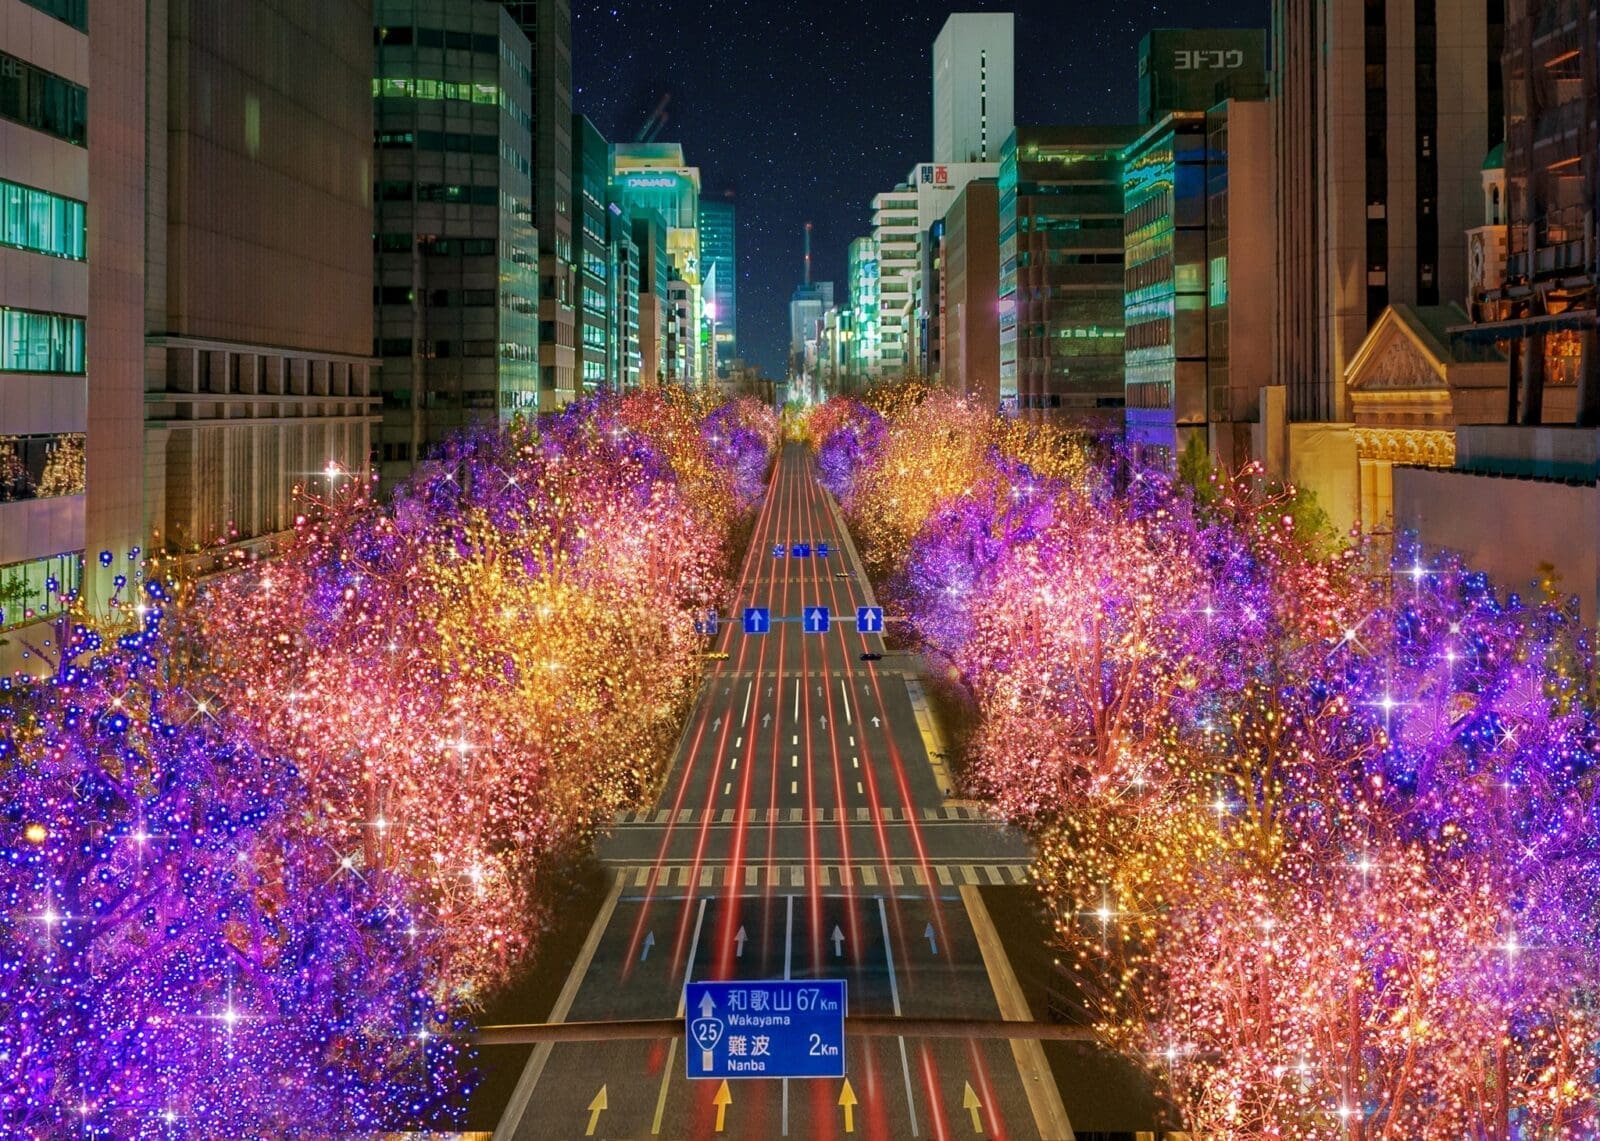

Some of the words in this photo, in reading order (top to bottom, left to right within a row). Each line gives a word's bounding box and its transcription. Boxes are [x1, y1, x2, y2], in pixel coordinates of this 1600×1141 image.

[1174, 49, 1243, 70] ヨドコウ
[921, 166, 948, 184] 関西
[727, 989, 792, 1012] 和歌山
[728, 1014, 791, 1028] Wakayama
[699, 1023, 717, 1041] 25
[728, 1035, 771, 1056] 難波
[728, 1060, 766, 1071] Nanba
